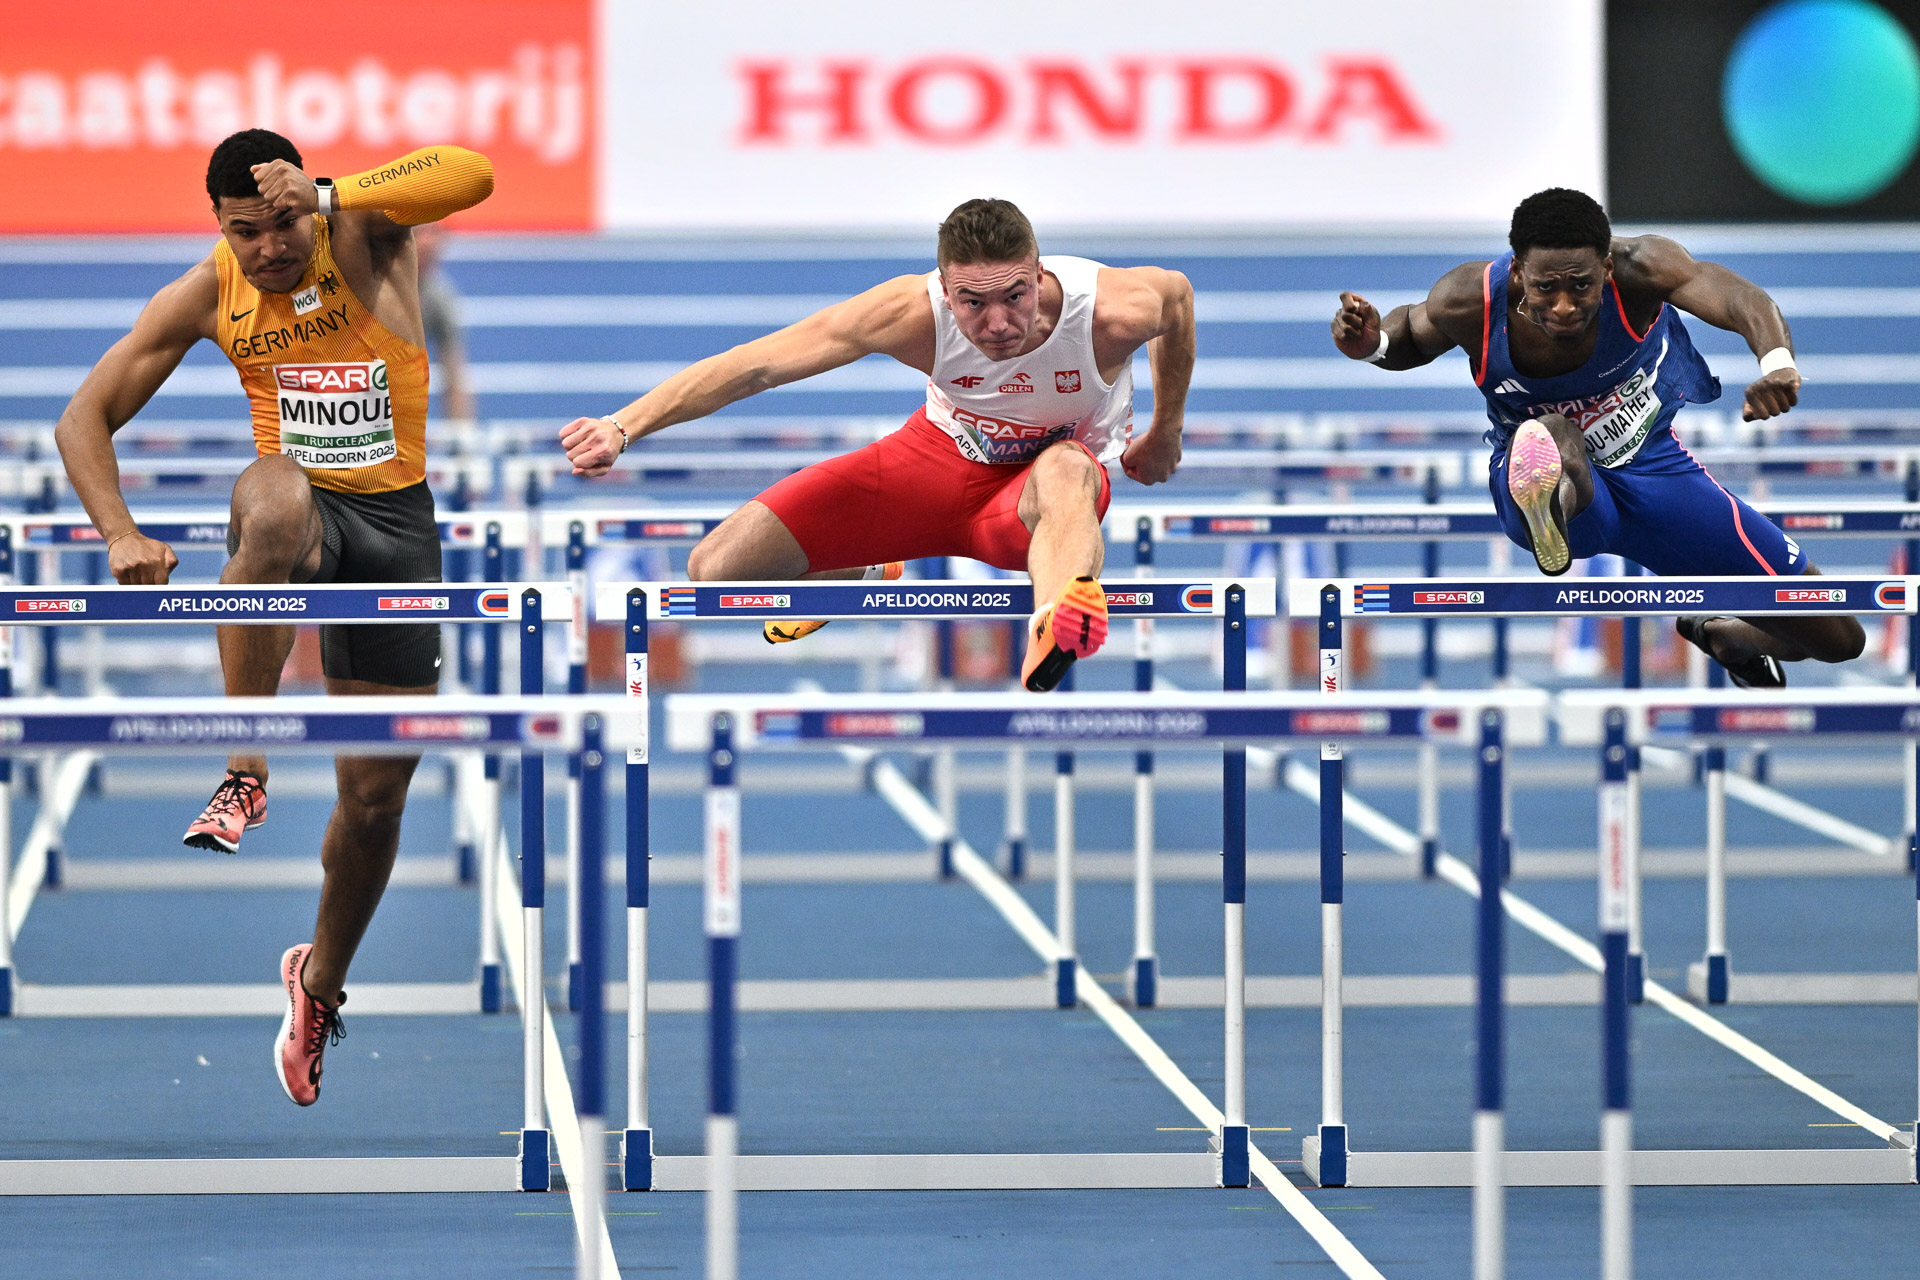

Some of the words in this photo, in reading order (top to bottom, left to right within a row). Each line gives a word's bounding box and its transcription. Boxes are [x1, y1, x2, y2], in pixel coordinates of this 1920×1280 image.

[735, 54, 1444, 149] HONDA
[359, 153, 441, 188] GERMANY
[294, 291, 318, 310] WGV
[233, 304, 351, 358] GERMANY
[279, 369, 368, 390] SPAR
[951, 375, 985, 389] 4F
[1001, 385, 1032, 393] ORLEN
[955, 412, 1044, 439] SPAR
[304, 436, 308, 445] I
[309, 435, 334, 447] RUN
[336, 432, 373, 447] CLEAN
[1616, 426, 1647, 457] CLEAN
[286, 449, 367, 464] APELDOORN
[369, 443, 396, 460] 2025
[732, 596, 774, 605] SPAR
[862, 593, 968, 608] APELDOORN
[971, 593, 1011, 607] 2025
[1106, 594, 1137, 603] PAR
[1426, 593, 1468, 602] SPAR
[1556, 590, 1662, 604] APELDOORN
[1665, 589, 1704, 604] 2025
[1788, 591, 1829, 600] SPAR
[28, 601, 70, 610] SPAR
[158, 598, 264, 612] APELDOORN
[267, 597, 307, 612] 2025
[390, 599, 432, 608] SPAR
[288, 950, 302, 977] new
[288, 980, 297, 1041] balance
